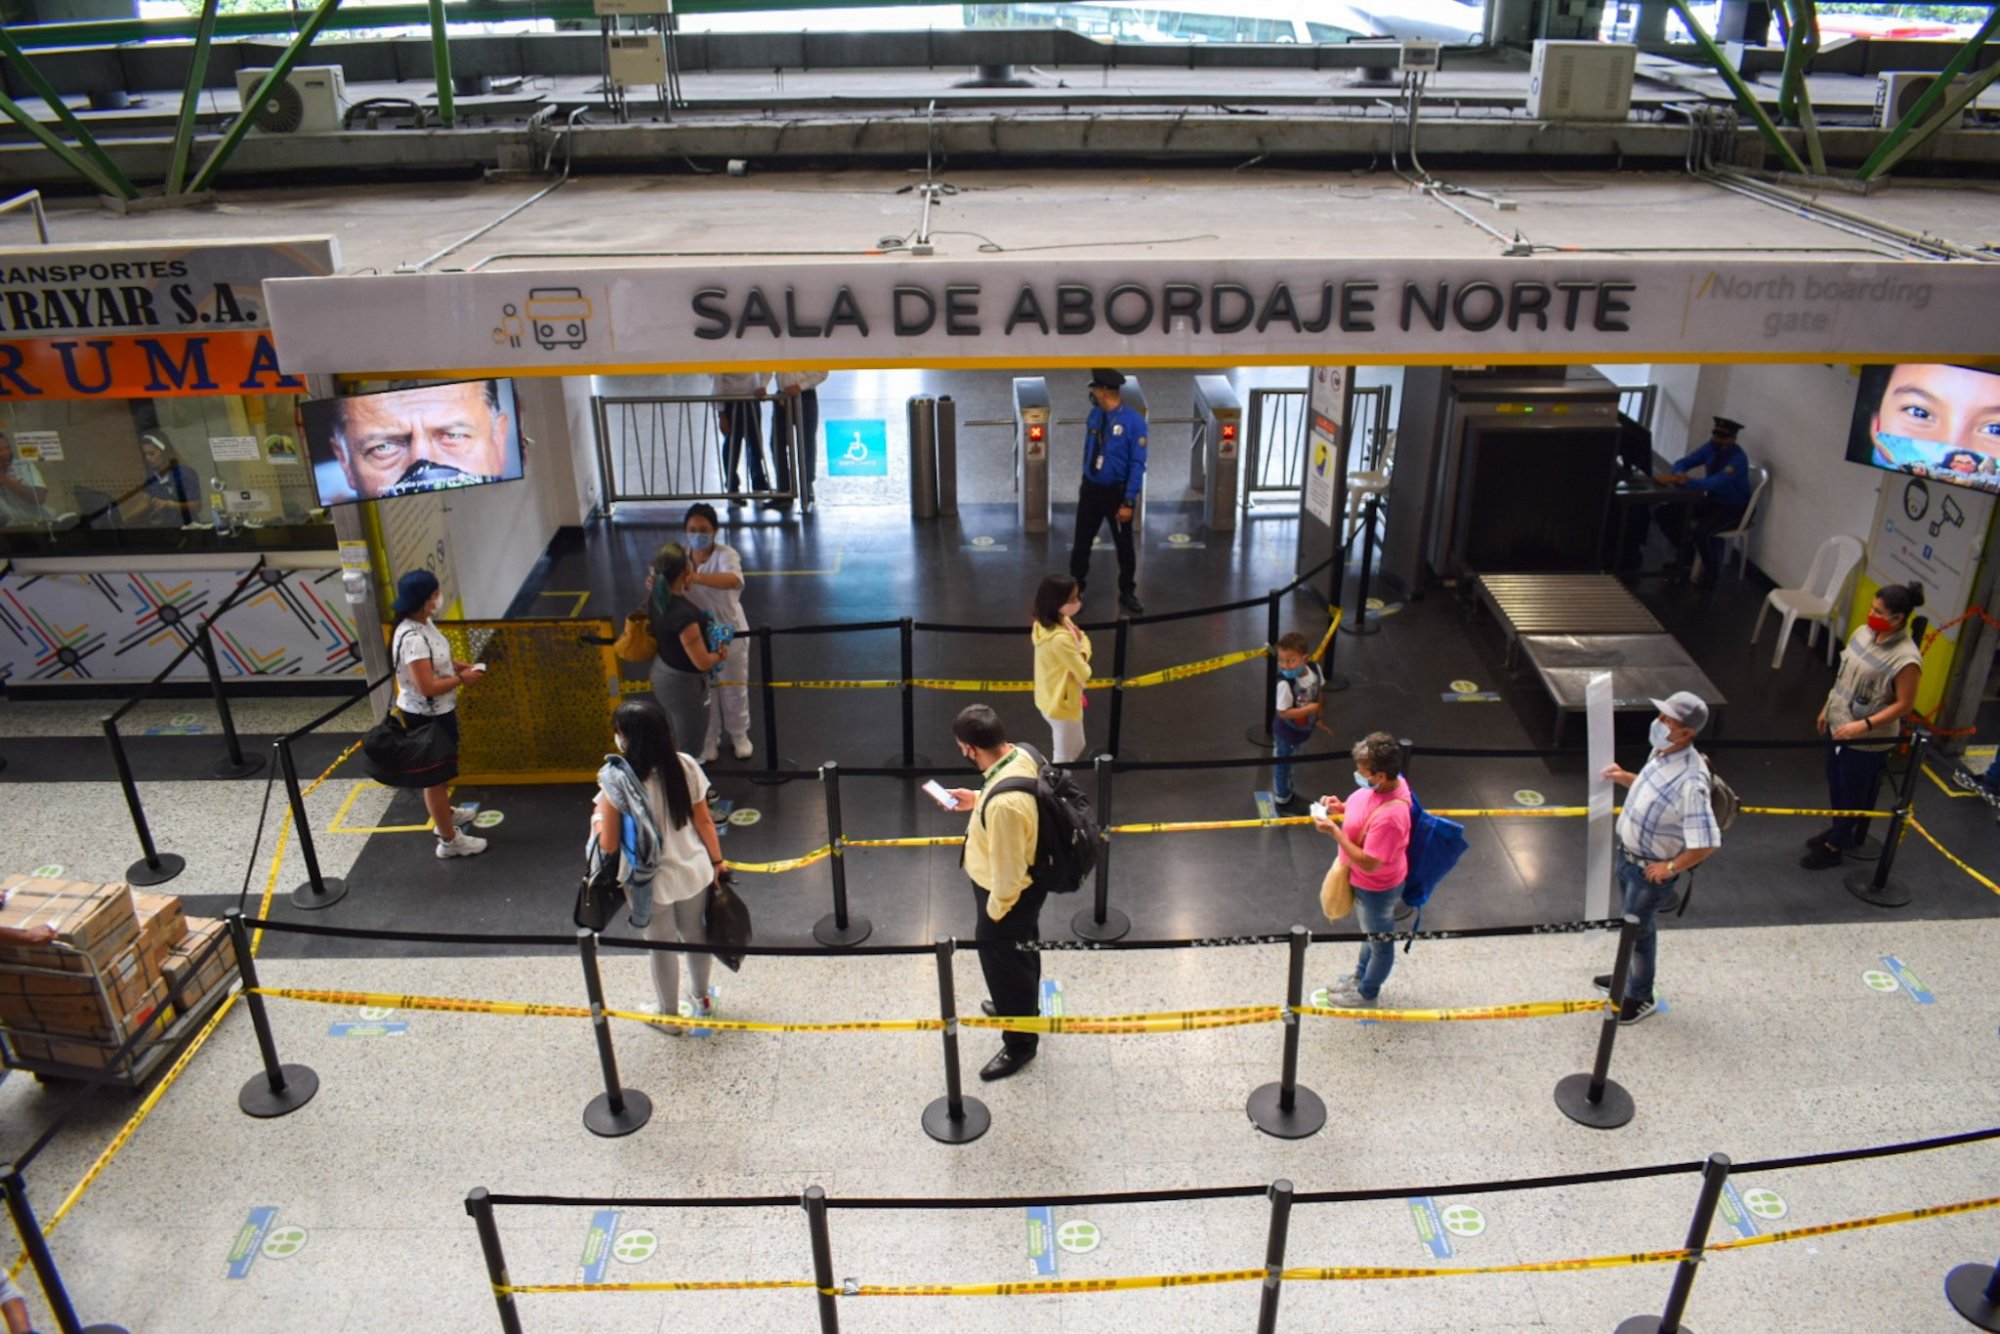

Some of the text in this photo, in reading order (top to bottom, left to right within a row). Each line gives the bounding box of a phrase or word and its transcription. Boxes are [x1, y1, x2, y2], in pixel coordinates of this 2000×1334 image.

[0, 283, 257, 331] RAYAR S.A.
[692, 281, 1637, 340] SALA DE ABORDAJE NORTE
[1712, 275, 1933, 309] North boarding
[1763, 311, 1830, 338] gate
